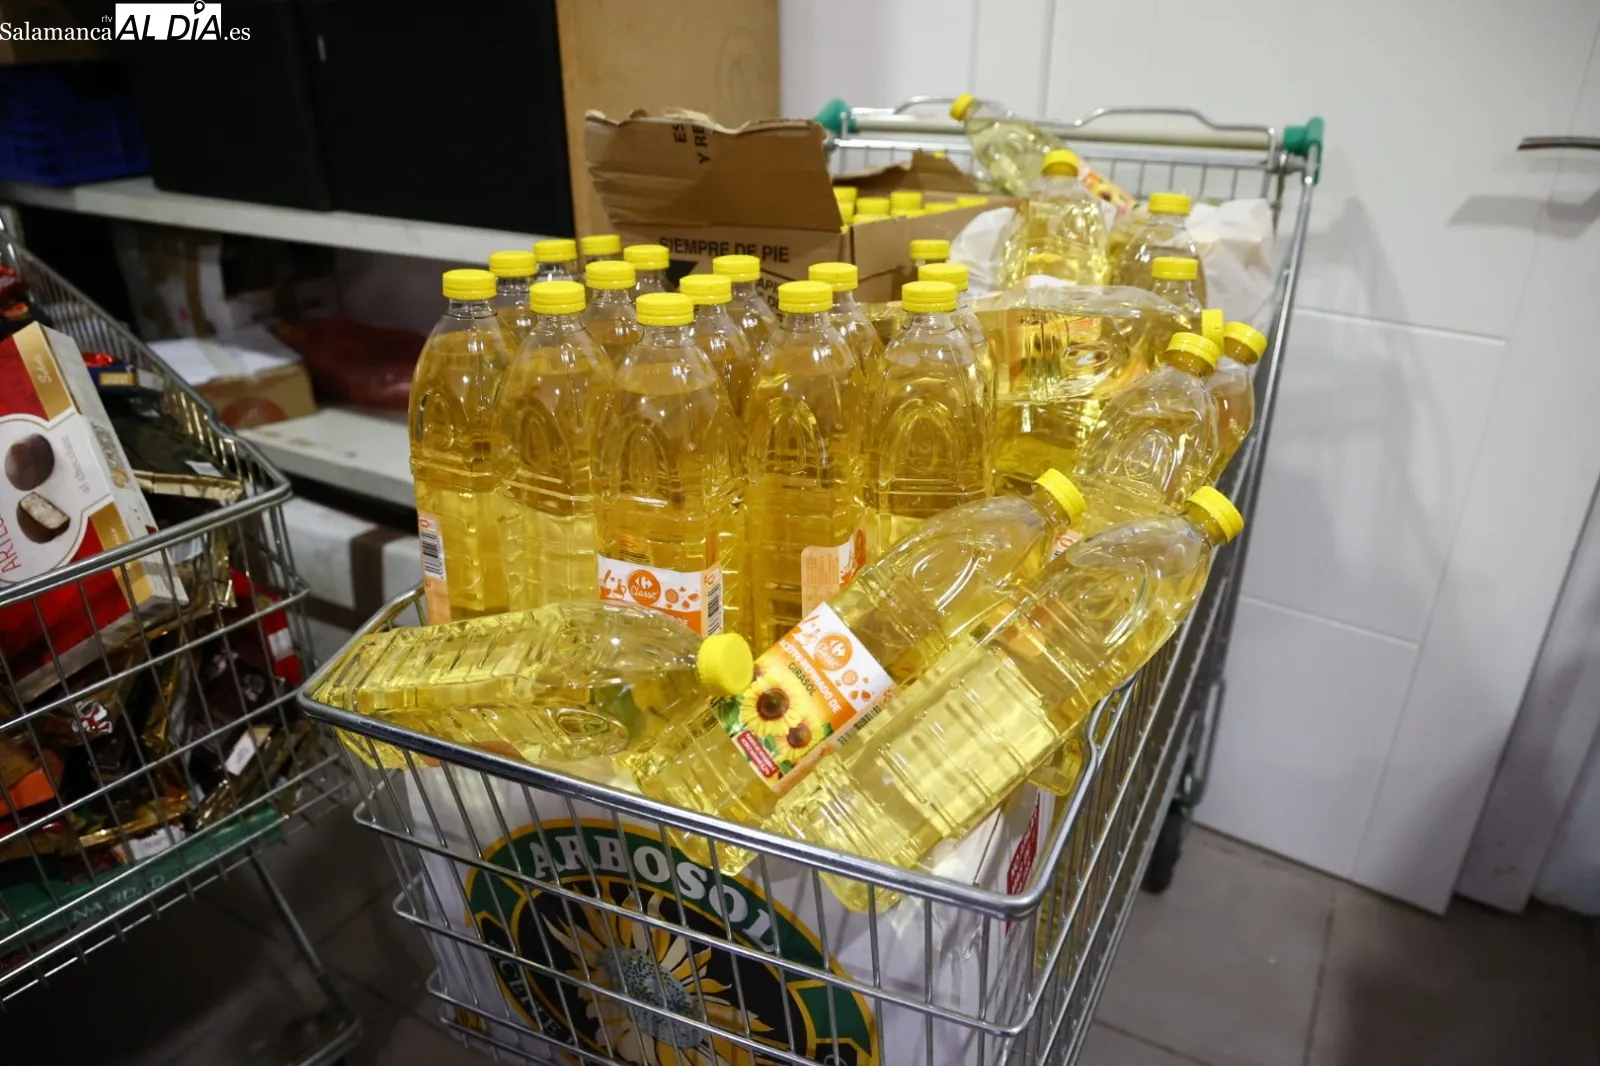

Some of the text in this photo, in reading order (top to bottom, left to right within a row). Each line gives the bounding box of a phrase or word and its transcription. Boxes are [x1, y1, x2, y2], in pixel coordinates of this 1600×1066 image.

[697, 151, 711, 165] Y
[659, 237, 789, 263] SIEMPRE DE PIE
[630, 584, 659, 599] Classic
[787, 661, 817, 697] GIRASOL
[828, 698, 841, 713] DE
[530, 834, 777, 954] ARBOSOL
